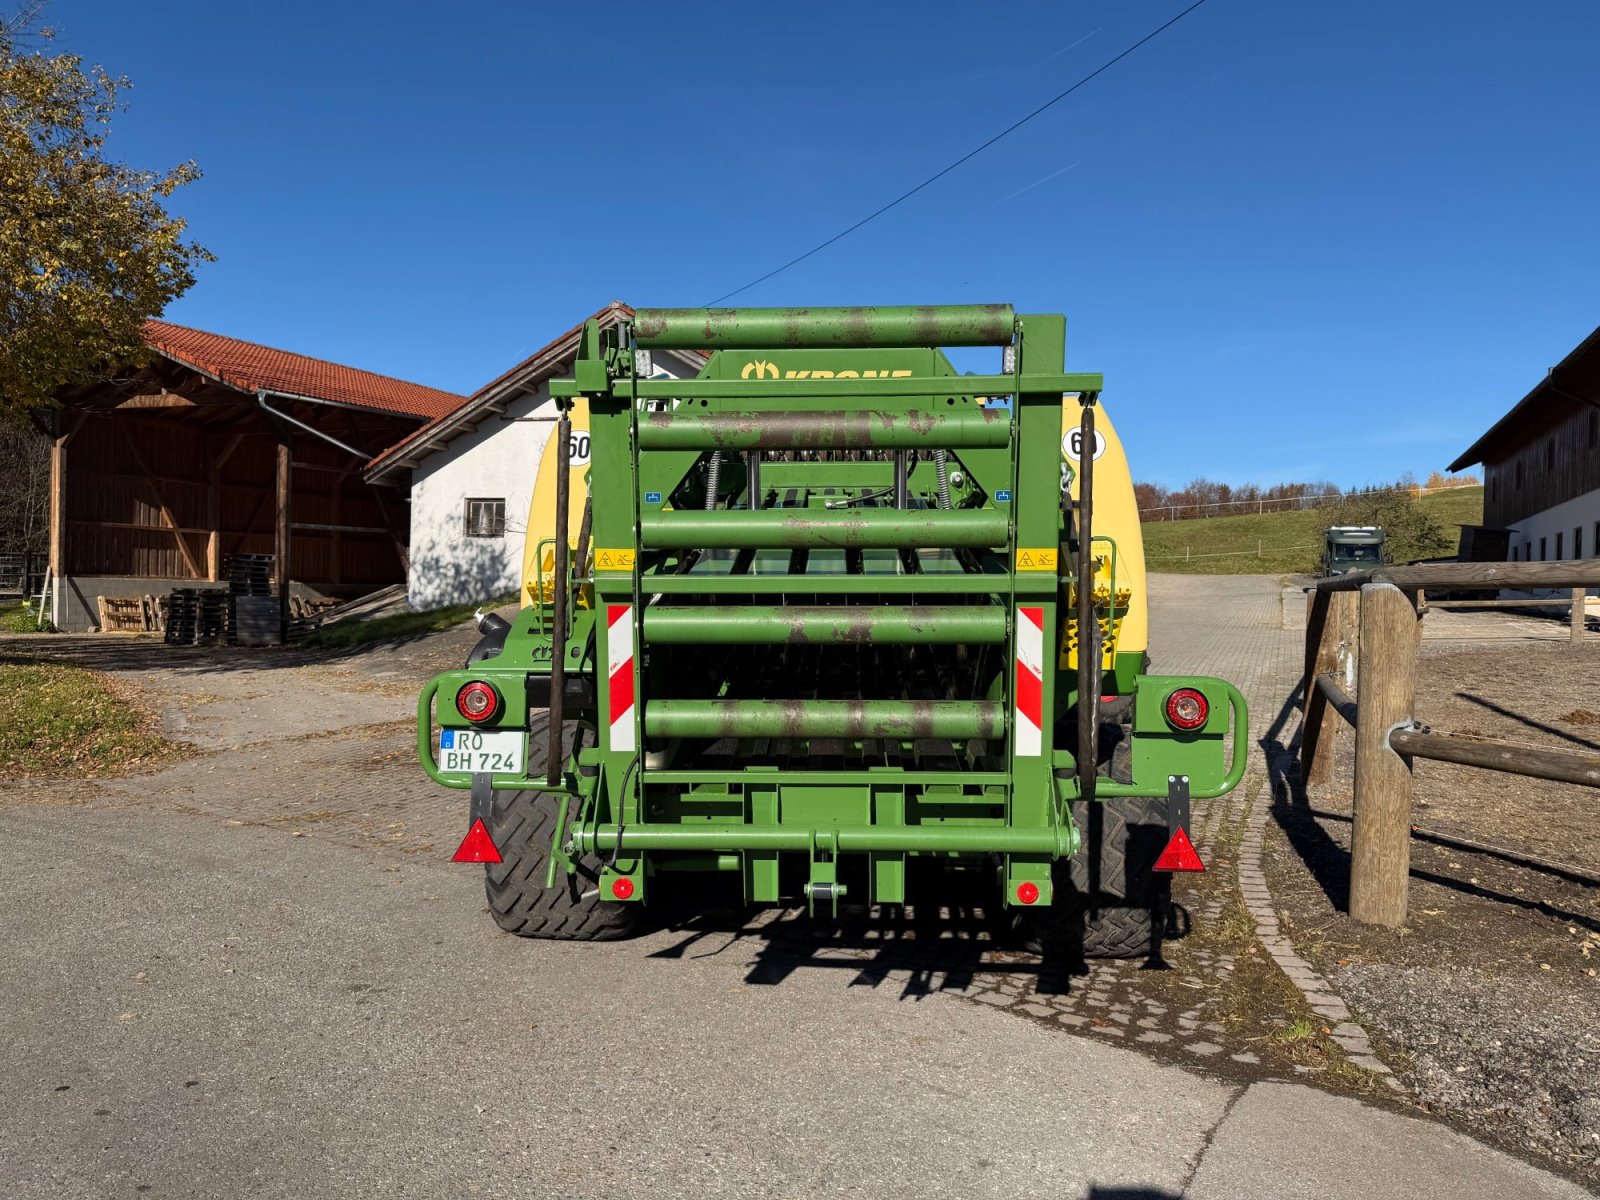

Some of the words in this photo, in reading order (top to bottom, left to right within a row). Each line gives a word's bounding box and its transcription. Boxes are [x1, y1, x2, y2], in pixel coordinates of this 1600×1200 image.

[1071, 432, 1097, 455] 6
[459, 733, 483, 750] RO
[447, 752, 472, 770] BH
[479, 752, 514, 770] 724
